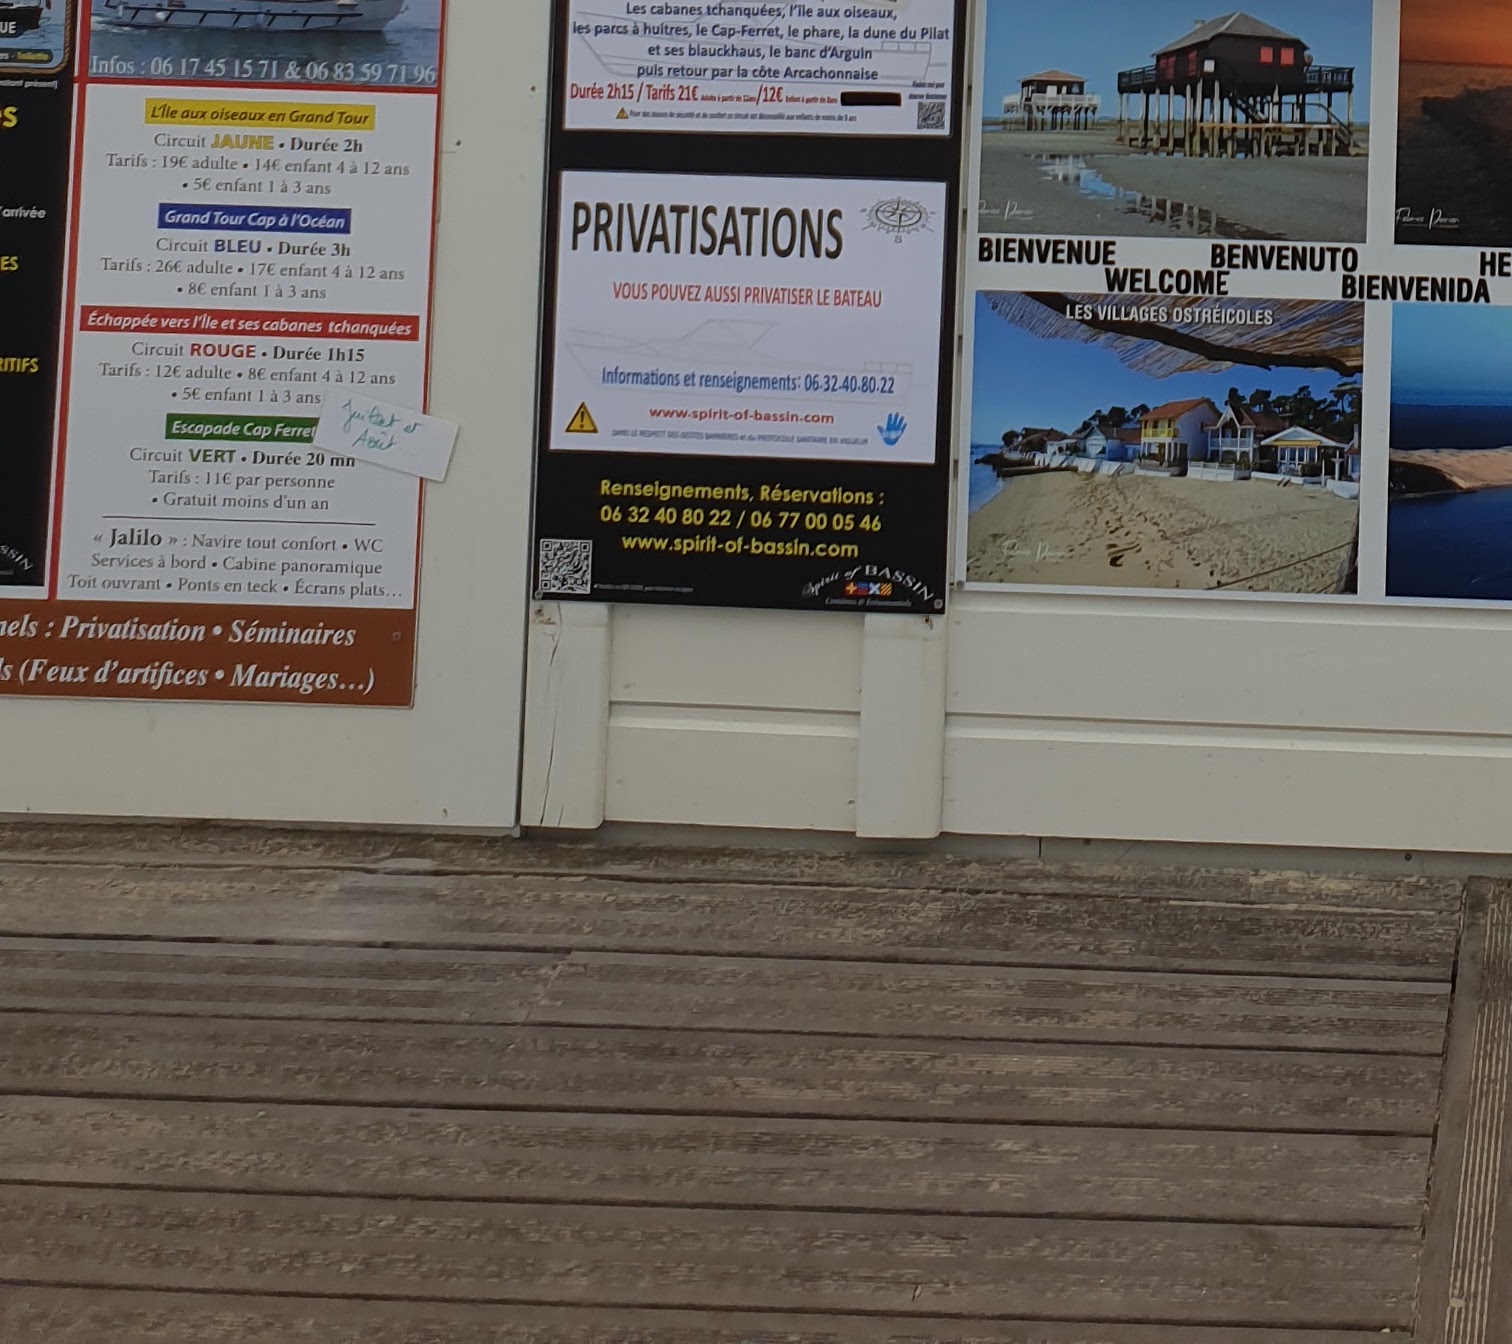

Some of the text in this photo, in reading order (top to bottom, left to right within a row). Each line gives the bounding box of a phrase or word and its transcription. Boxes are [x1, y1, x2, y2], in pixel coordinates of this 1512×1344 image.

[184, 107, 207, 121] aux
[210, 107, 265, 123] oiseaux
[268, 110, 286, 123] en
[289, 109, 334, 125] Grand
[337, 111, 369, 125] Tour
[165, 209, 345, 231] Grand Tour Cap à l'Océan
[572, 201, 843, 260] PRIVATISATIONS
[156, 237, 351, 257] Circuit BLEU Durée 3h
[977, 237, 1117, 265] BIENVENUE
[1211, 244, 1358, 272] BENVENUTO
[613, 281, 882, 308] VOUS POUVEZ AUSSI PRIVATISER LE BATEAU
[1105, 267, 1490, 304] WELCOME BIENVENIDA
[600, 478, 874, 506] Renseignements, Réservations
[622, 534, 858, 558] www.spirit-of-bassin.com
[60, 615, 355, 646] Privatisation Séminaires
[94, 659, 208, 689] d'artifices
